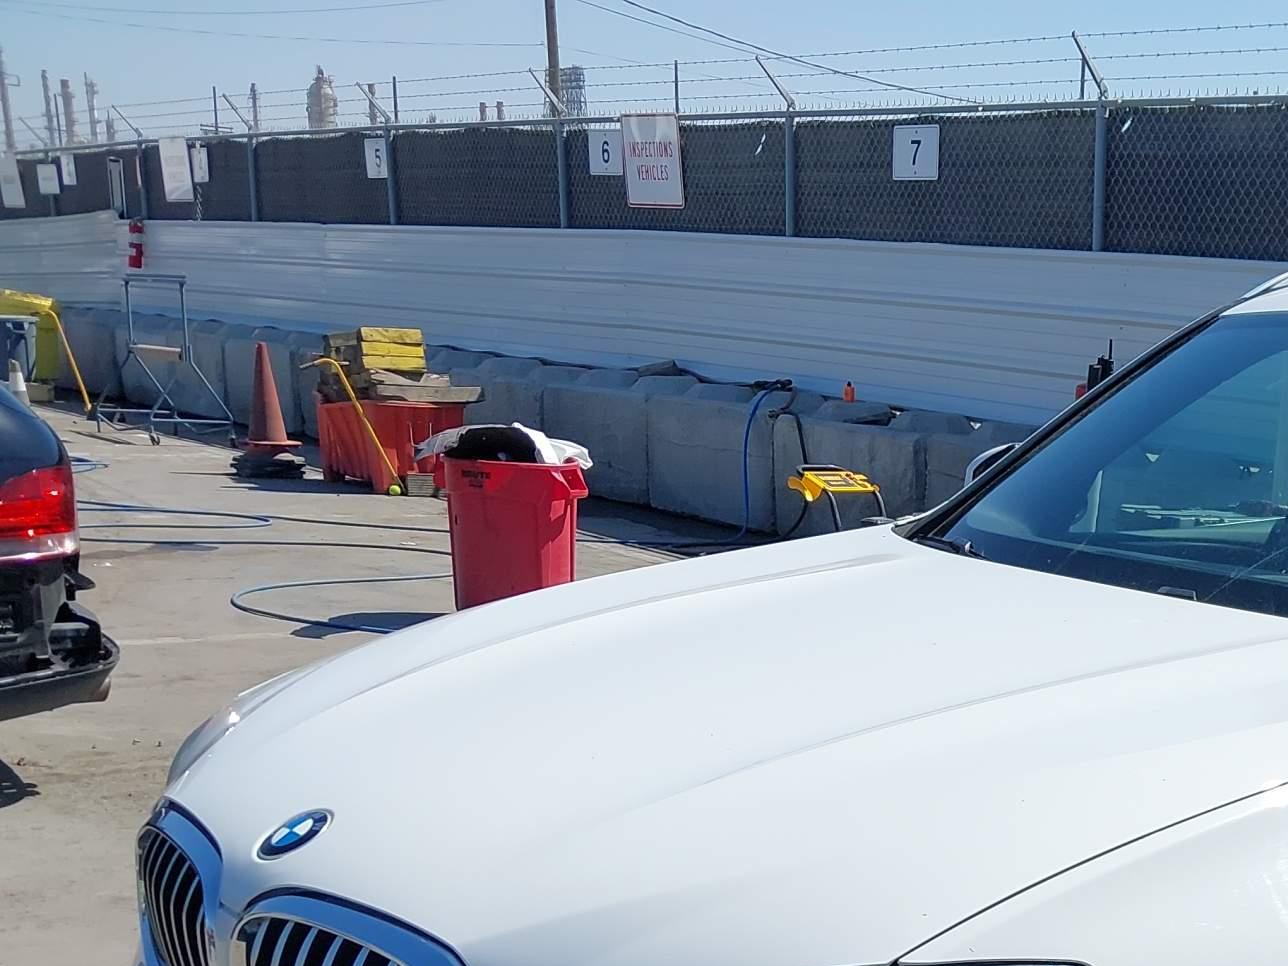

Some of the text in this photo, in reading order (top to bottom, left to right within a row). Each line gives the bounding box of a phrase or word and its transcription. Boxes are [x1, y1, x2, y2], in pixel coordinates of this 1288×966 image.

[375, 149, 381, 168] 5
[602, 141, 610, 163] 6
[629, 141, 673, 158] INSPECTIONS
[911, 140, 921, 166] 7
[637, 164, 669, 180] VEHICLES
